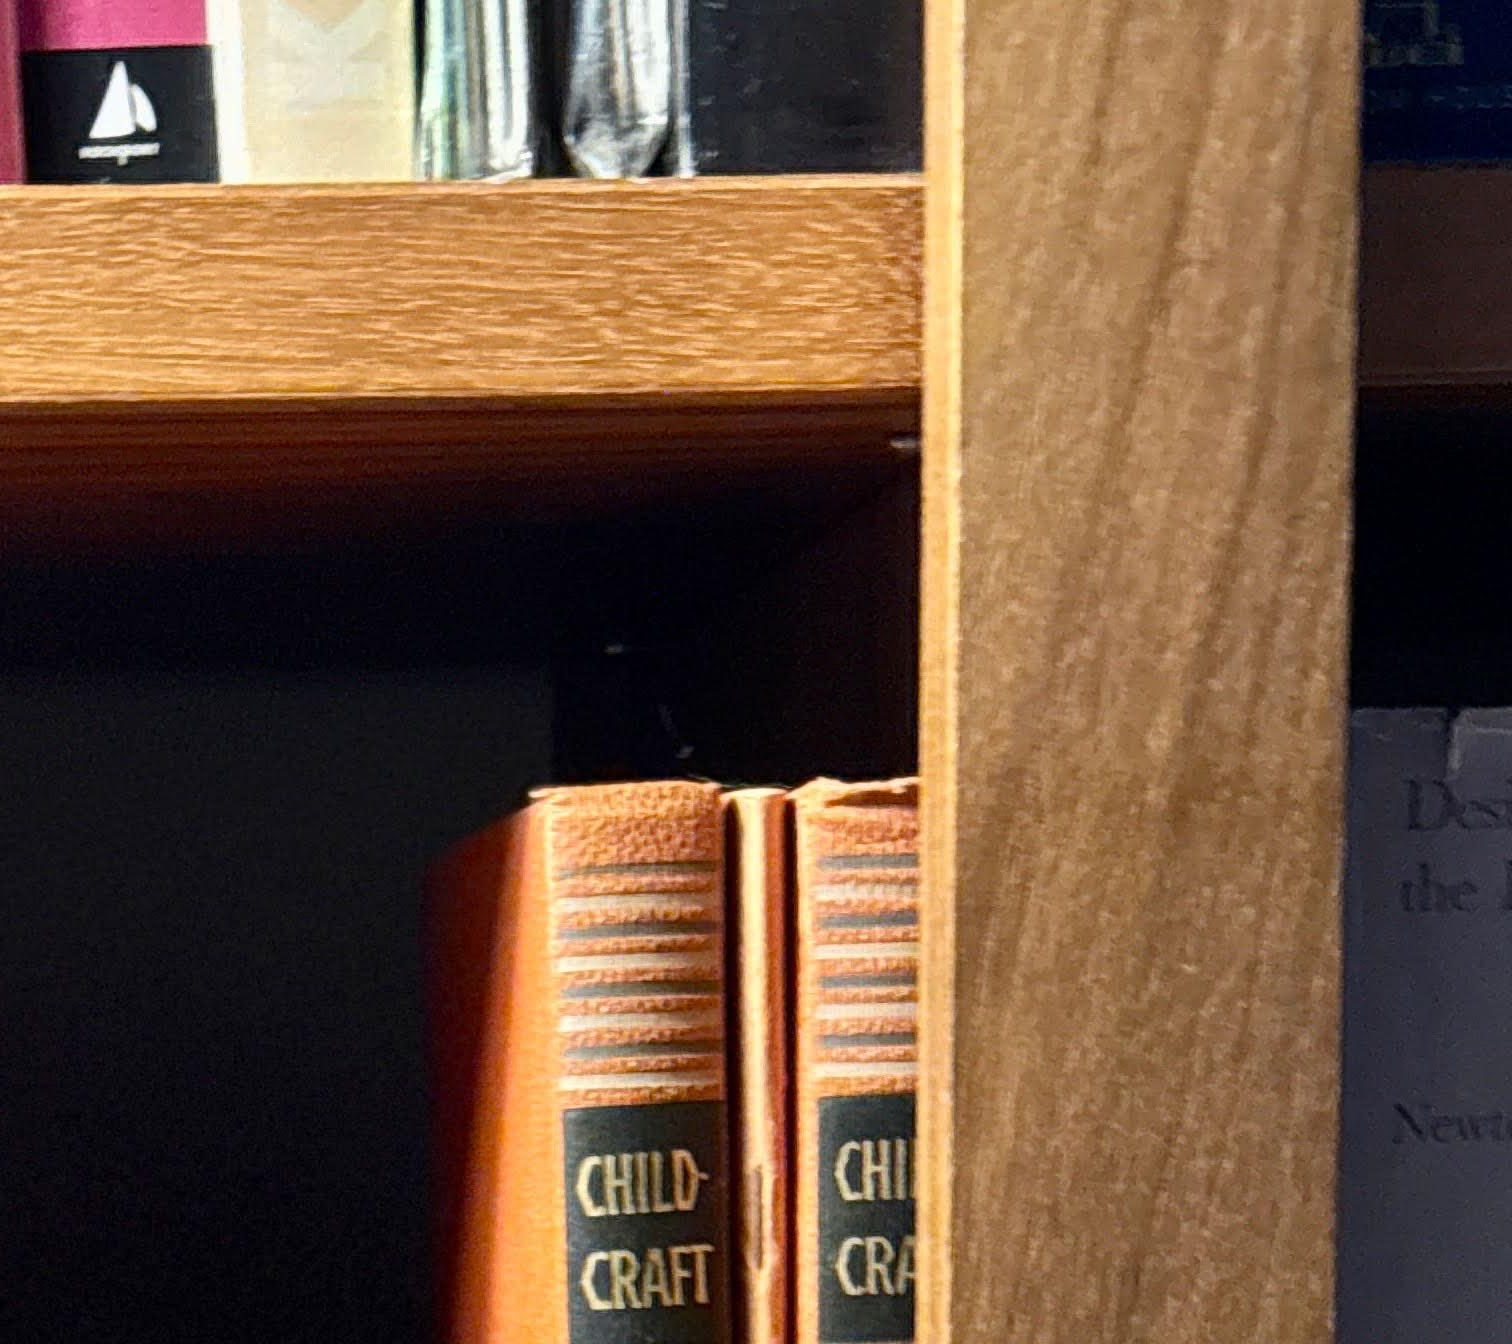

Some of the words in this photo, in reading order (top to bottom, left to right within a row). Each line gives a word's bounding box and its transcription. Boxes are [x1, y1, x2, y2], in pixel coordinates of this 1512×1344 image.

[1403, 777, 1512, 832] Des
[834, 1137, 916, 1201] CHI
[580, 1244, 716, 1311] CRAFT
